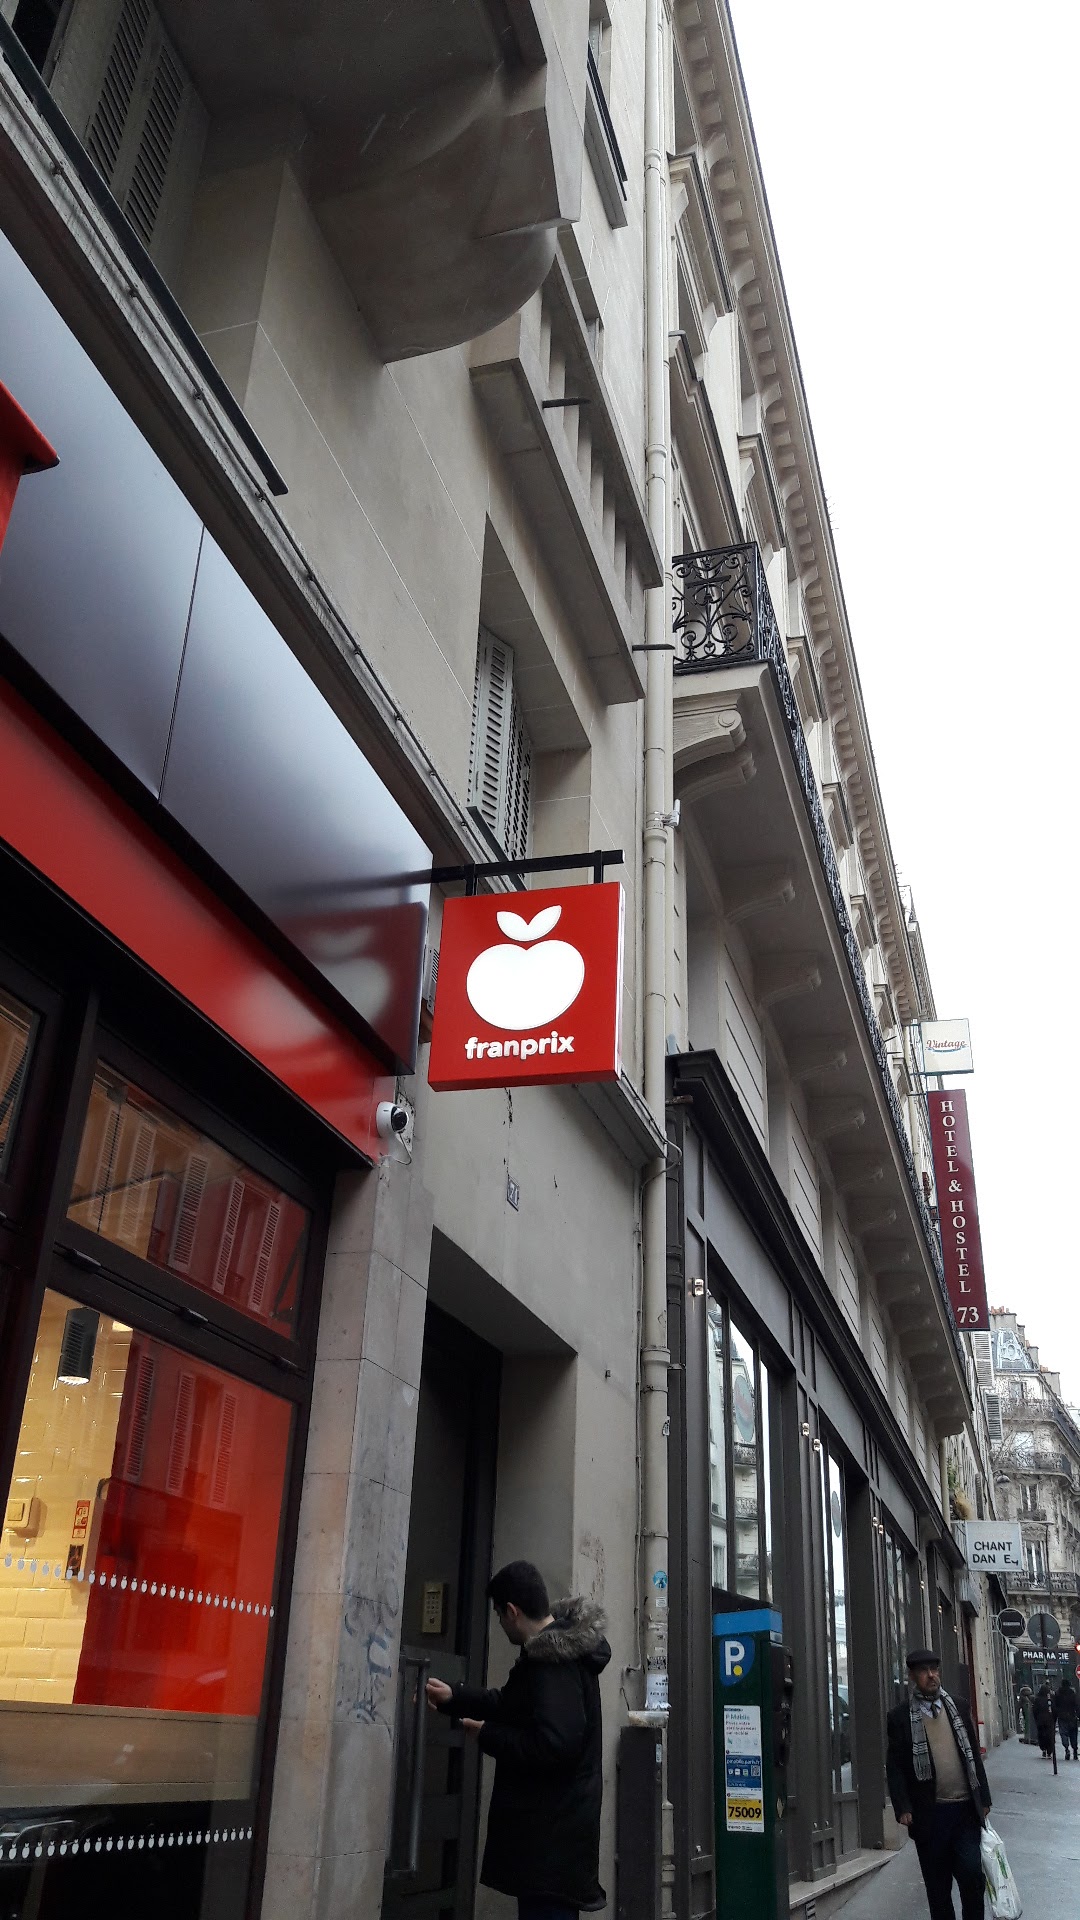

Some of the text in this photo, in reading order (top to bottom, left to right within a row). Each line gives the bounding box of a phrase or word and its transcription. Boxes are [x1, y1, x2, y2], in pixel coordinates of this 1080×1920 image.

[464, 1030, 575, 1060] franprix
[926, 1039, 967, 1050] Vintage
[940, 1100, 971, 1293] HOTEL & HOSTEL
[956, 1306, 980, 1323] 73
[973, 1541, 1012, 1551] CHANT
[724, 1640, 745, 1676] P
[728, 1806, 762, 1818] 75009
